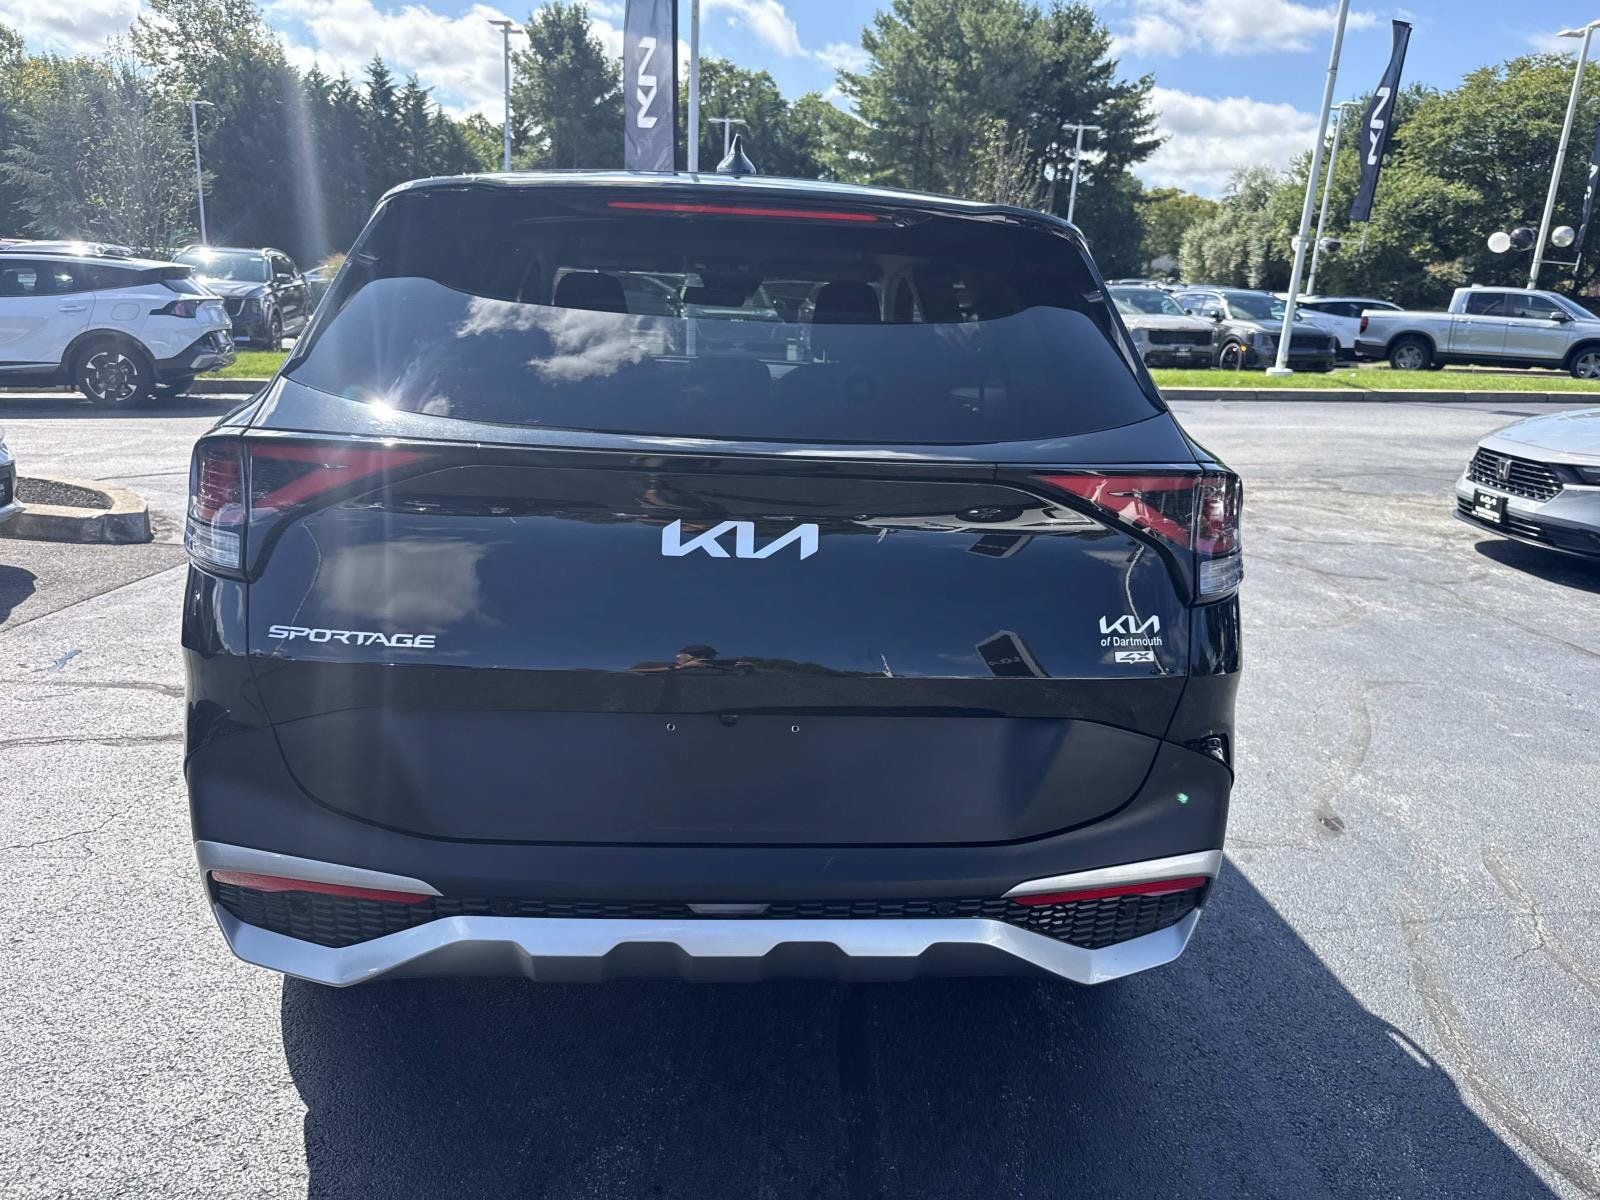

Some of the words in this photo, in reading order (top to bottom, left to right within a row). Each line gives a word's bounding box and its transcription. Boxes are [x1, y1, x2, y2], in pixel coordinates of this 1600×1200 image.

[661, 518, 819, 560] KIA
[1099, 614, 1160, 634] KIA
[268, 624, 436, 648] SPORTAGE
[1100, 637, 1111, 646] of
[1113, 636, 1163, 646] Dartmouth
